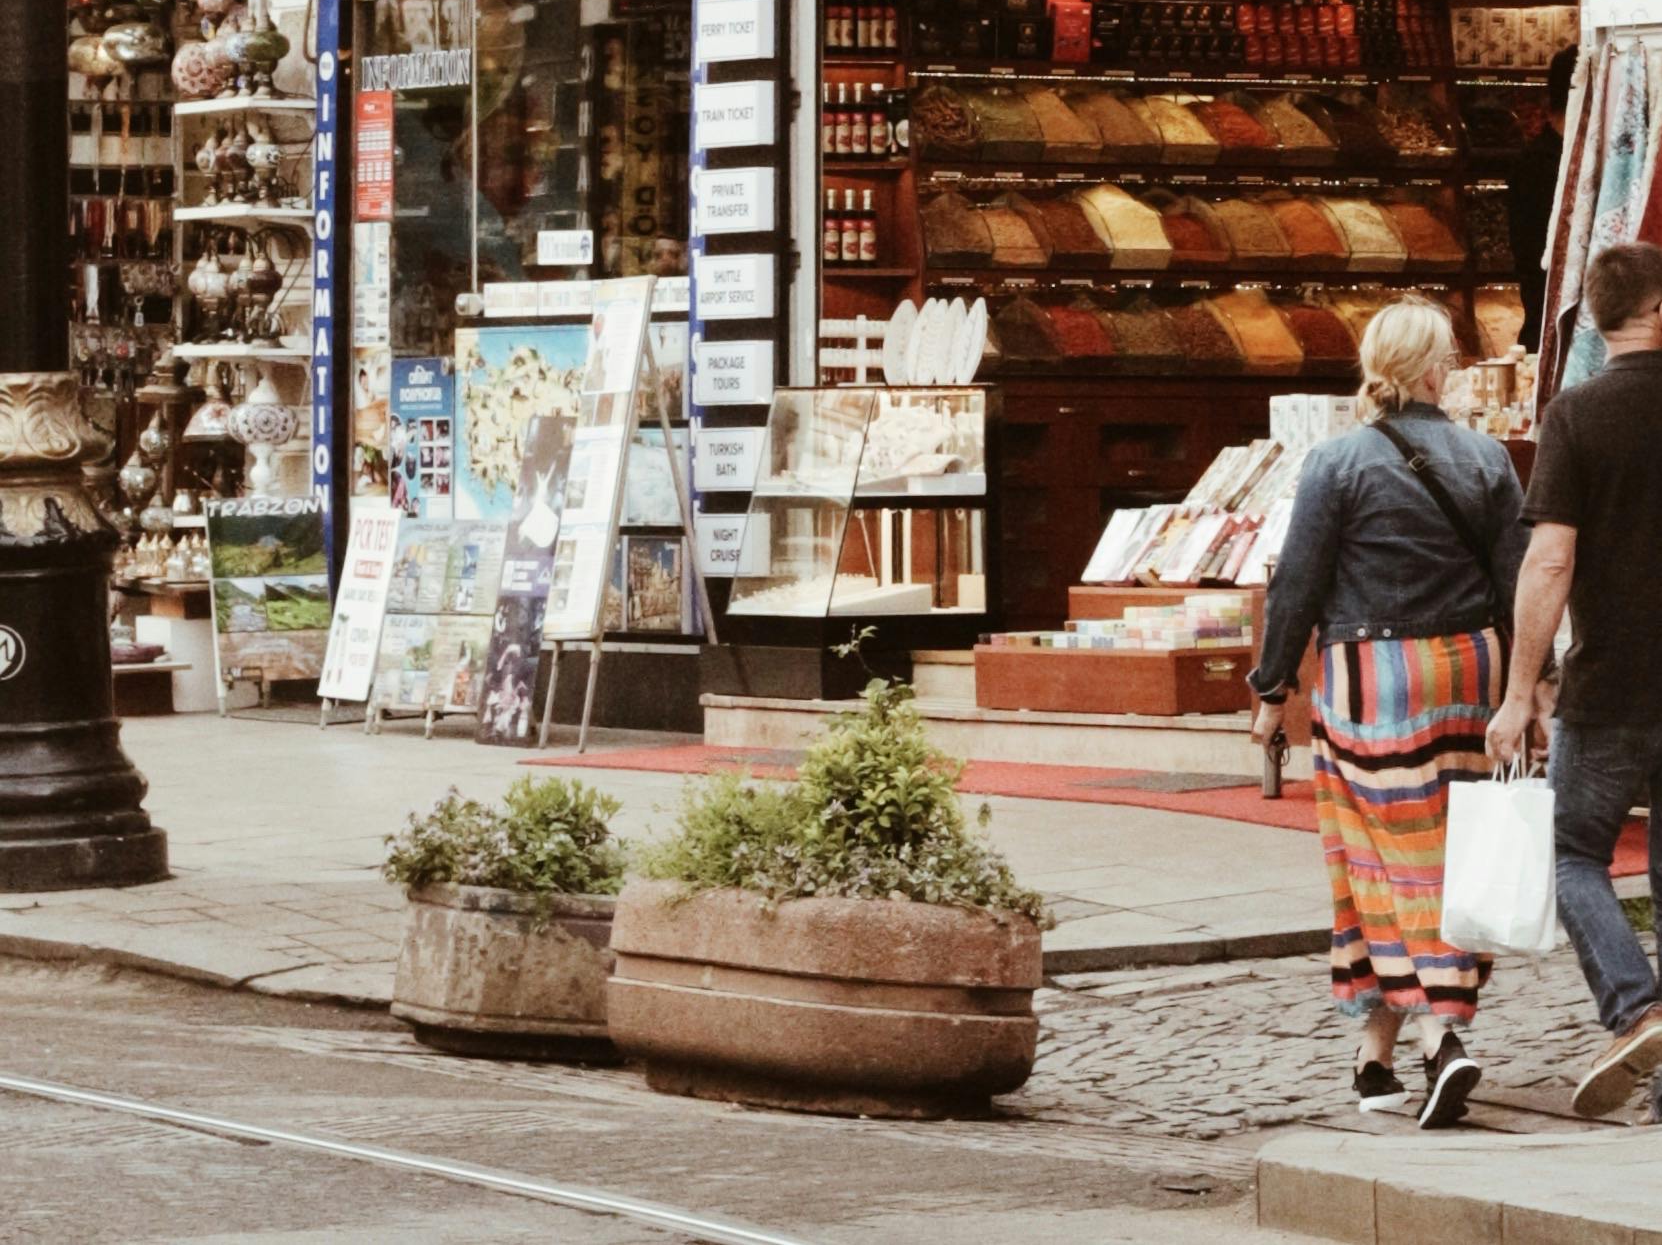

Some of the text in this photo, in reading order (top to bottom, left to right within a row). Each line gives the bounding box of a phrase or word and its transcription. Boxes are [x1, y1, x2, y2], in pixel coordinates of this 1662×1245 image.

[701, 19, 755, 37] FERRY TICKET
[361, 49, 471, 91] INFORMATION
[701, 106, 755, 122] TRAIN TICKET
[711, 182, 745, 197] PRIVATE
[706, 203, 749, 218] TRANSFER
[312, 93, 332, 514] INFORMATION
[728, 290, 755, 303] SERVICE
[708, 356, 745, 371] PACKAGE
[713, 377, 740, 391] TOURS
[708, 442, 744, 457] TURKISH
[715, 463, 737, 478] BATH
[207, 497, 321, 517] TRABZON
[713, 527, 739, 542] NIGHT
